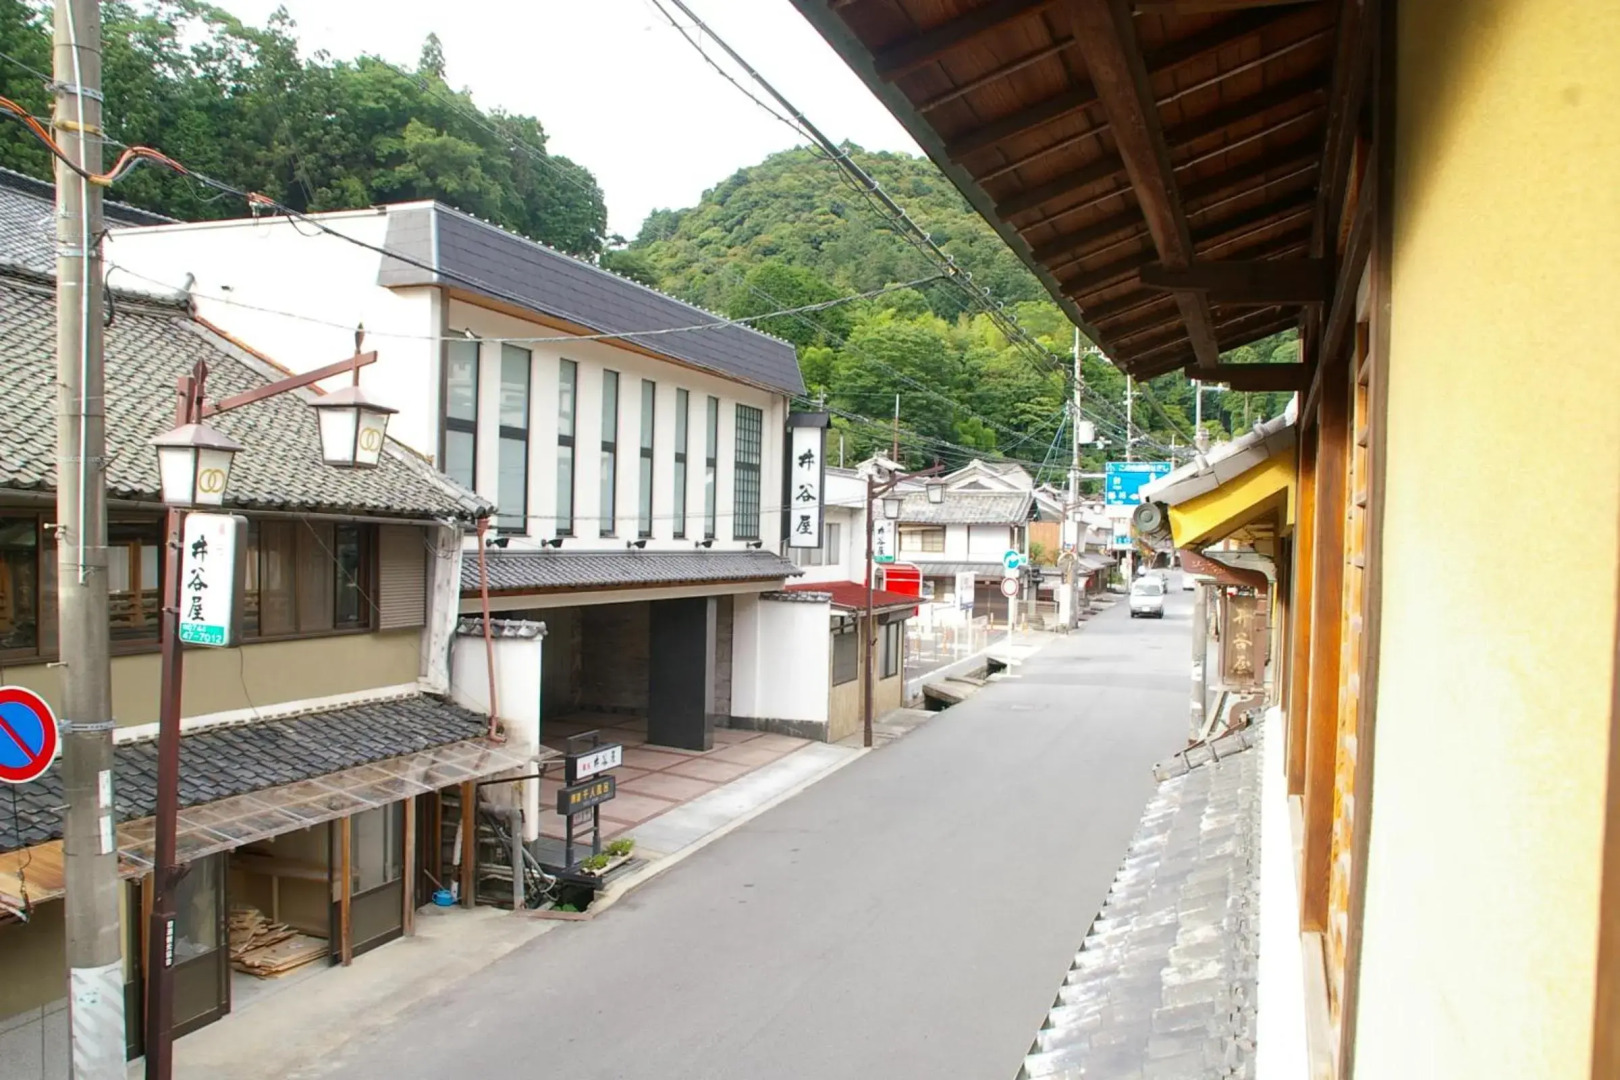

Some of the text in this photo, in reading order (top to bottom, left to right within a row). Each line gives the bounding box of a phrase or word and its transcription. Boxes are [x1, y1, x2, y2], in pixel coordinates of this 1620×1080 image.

[796, 448, 816, 535] 井谷屋
[187, 534, 208, 621] 井谷屋
[182, 631, 222, 643] 47-7012
